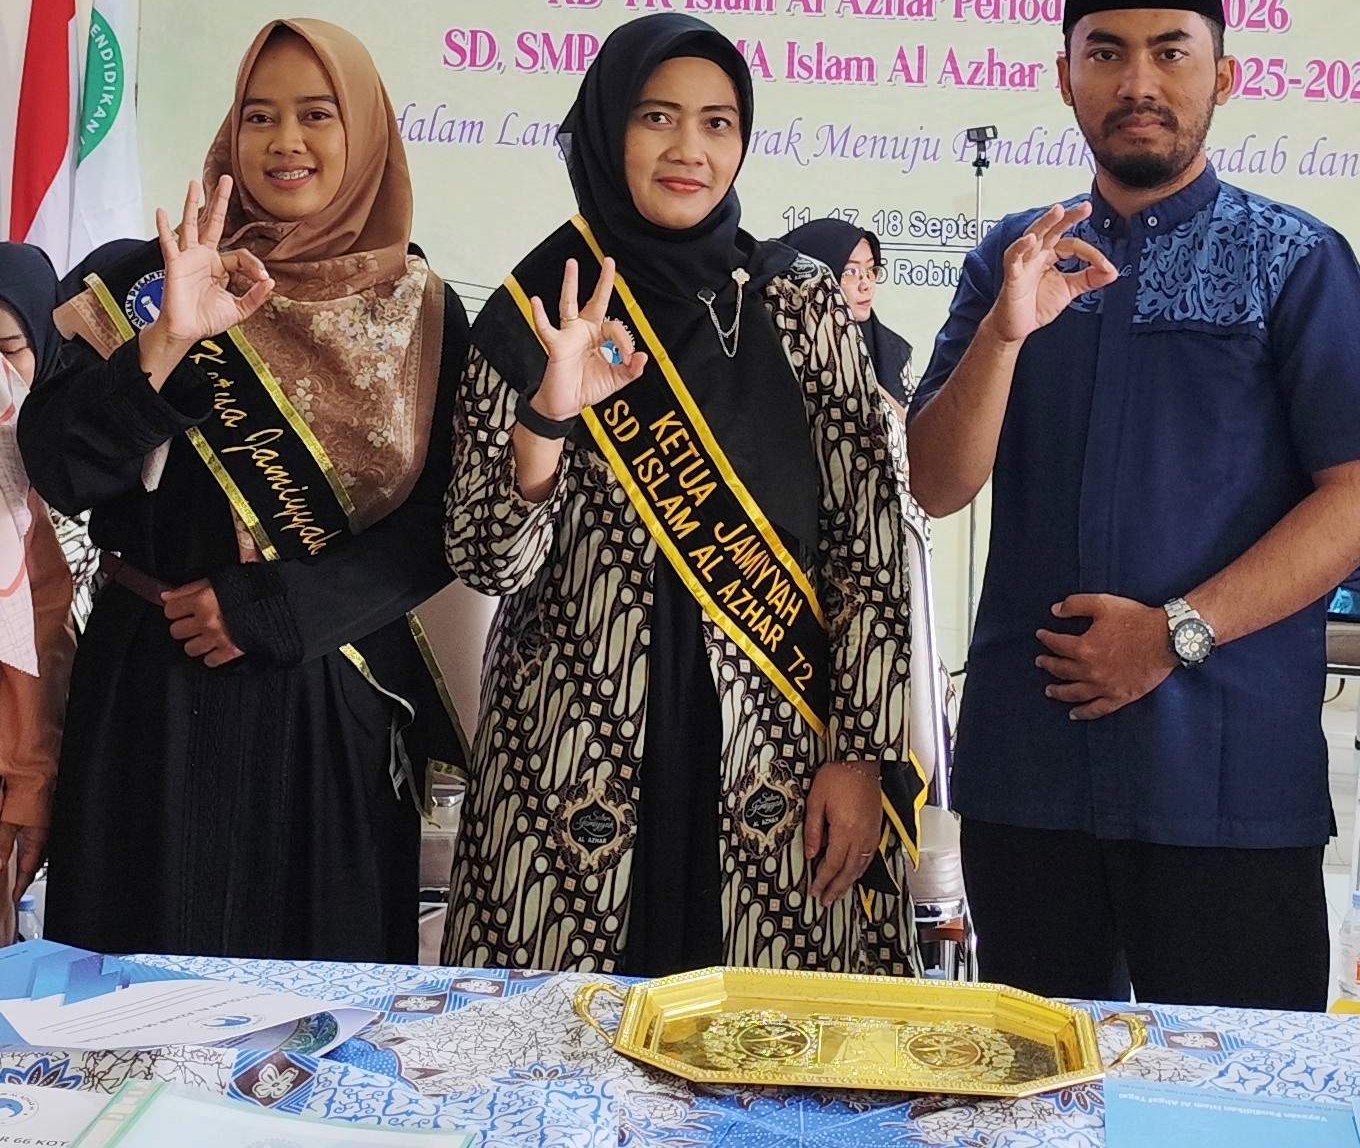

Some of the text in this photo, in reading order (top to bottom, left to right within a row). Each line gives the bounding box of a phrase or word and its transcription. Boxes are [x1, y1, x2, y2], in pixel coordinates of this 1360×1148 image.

[90, 23, 117, 134] ENDIDIKAN
[442, 28, 504, 71] SD,
[785, 41, 876, 82] Islam
[889, 45, 925, 84] Al
[940, 47, 1044, 89] Azhar
[750, 117, 810, 166] rak
[813, 123, 942, 174] Menuju
[1298, 136, 1360, 177] dan
[872, 209, 904, 236] 18
[602, 399, 641, 443] SD
[632, 448, 702, 542] ISLAM
[690, 542, 728, 583] AL
[715, 579, 785, 655] AZHAR
[787, 649, 818, 692] 72
[649, 409, 804, 628] KETUA JAMIYYAH
